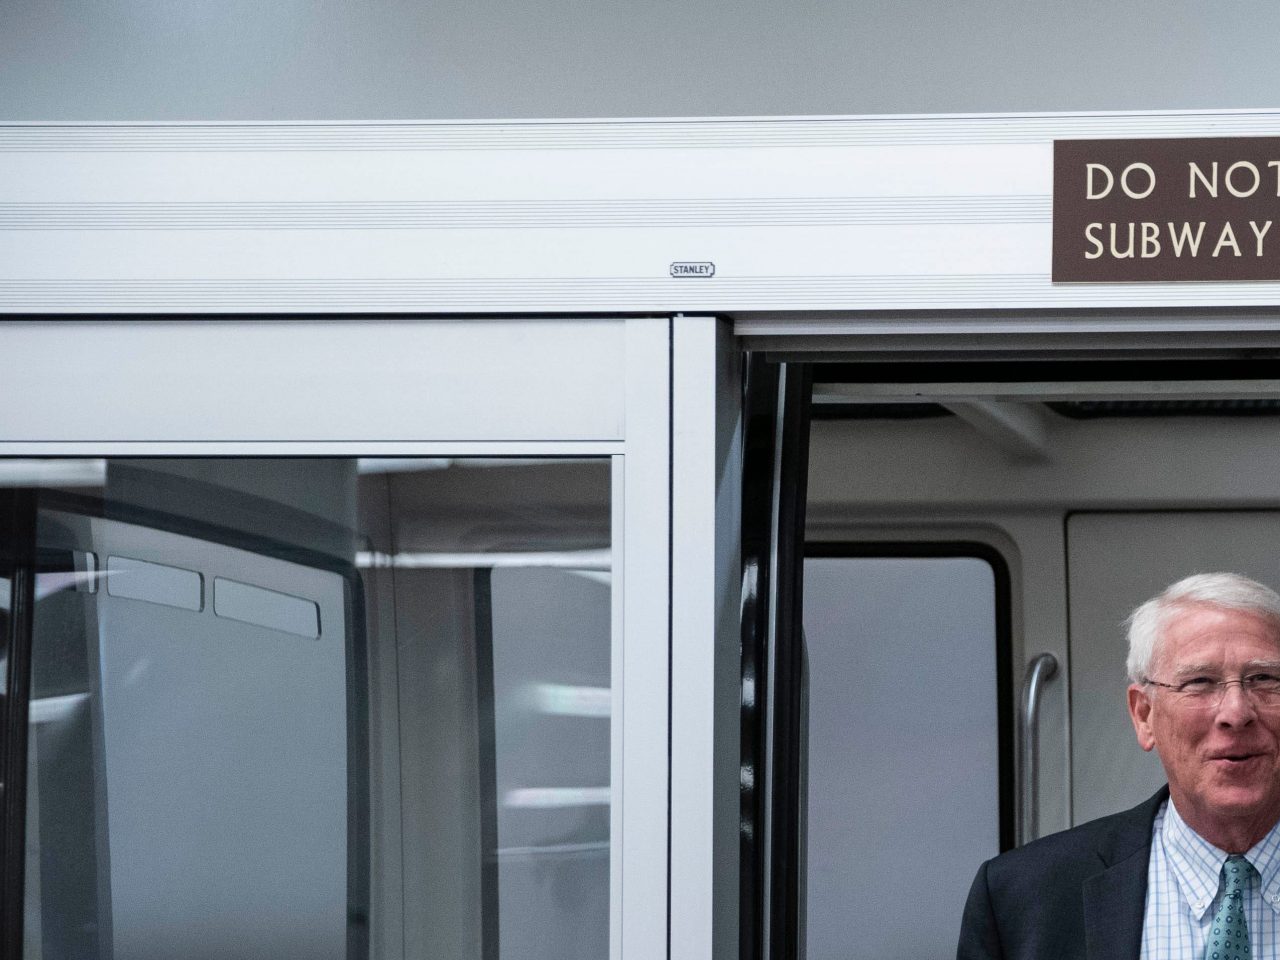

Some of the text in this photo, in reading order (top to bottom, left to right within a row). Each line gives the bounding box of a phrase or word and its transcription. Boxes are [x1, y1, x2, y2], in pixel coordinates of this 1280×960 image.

[1086, 162, 1156, 200] DO
[1084, 220, 1273, 260] SUBWAY
[673, 265, 710, 274] STANLEY
